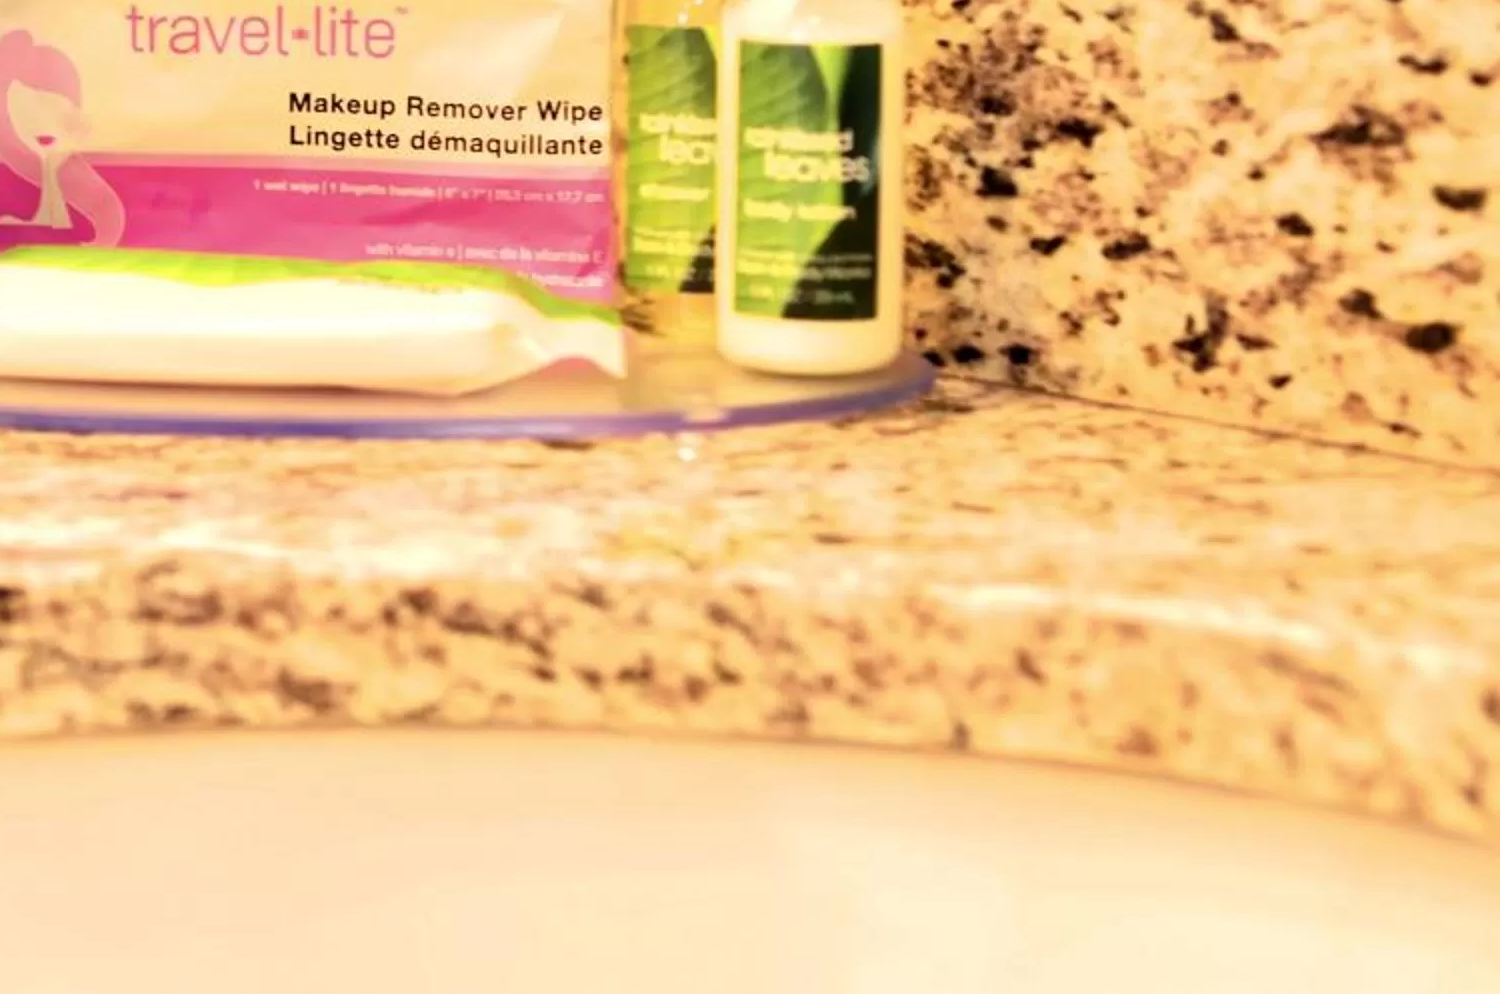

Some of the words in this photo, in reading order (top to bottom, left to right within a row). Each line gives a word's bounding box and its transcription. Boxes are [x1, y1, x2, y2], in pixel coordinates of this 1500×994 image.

[289, 92, 397, 119] Makeup
[407, 95, 528, 121] Remover
[537, 100, 604, 125] Wipe
[289, 125, 401, 152] Lingette
[410, 129, 604, 158] démaquillante
[764, 152, 871, 183] leaves
